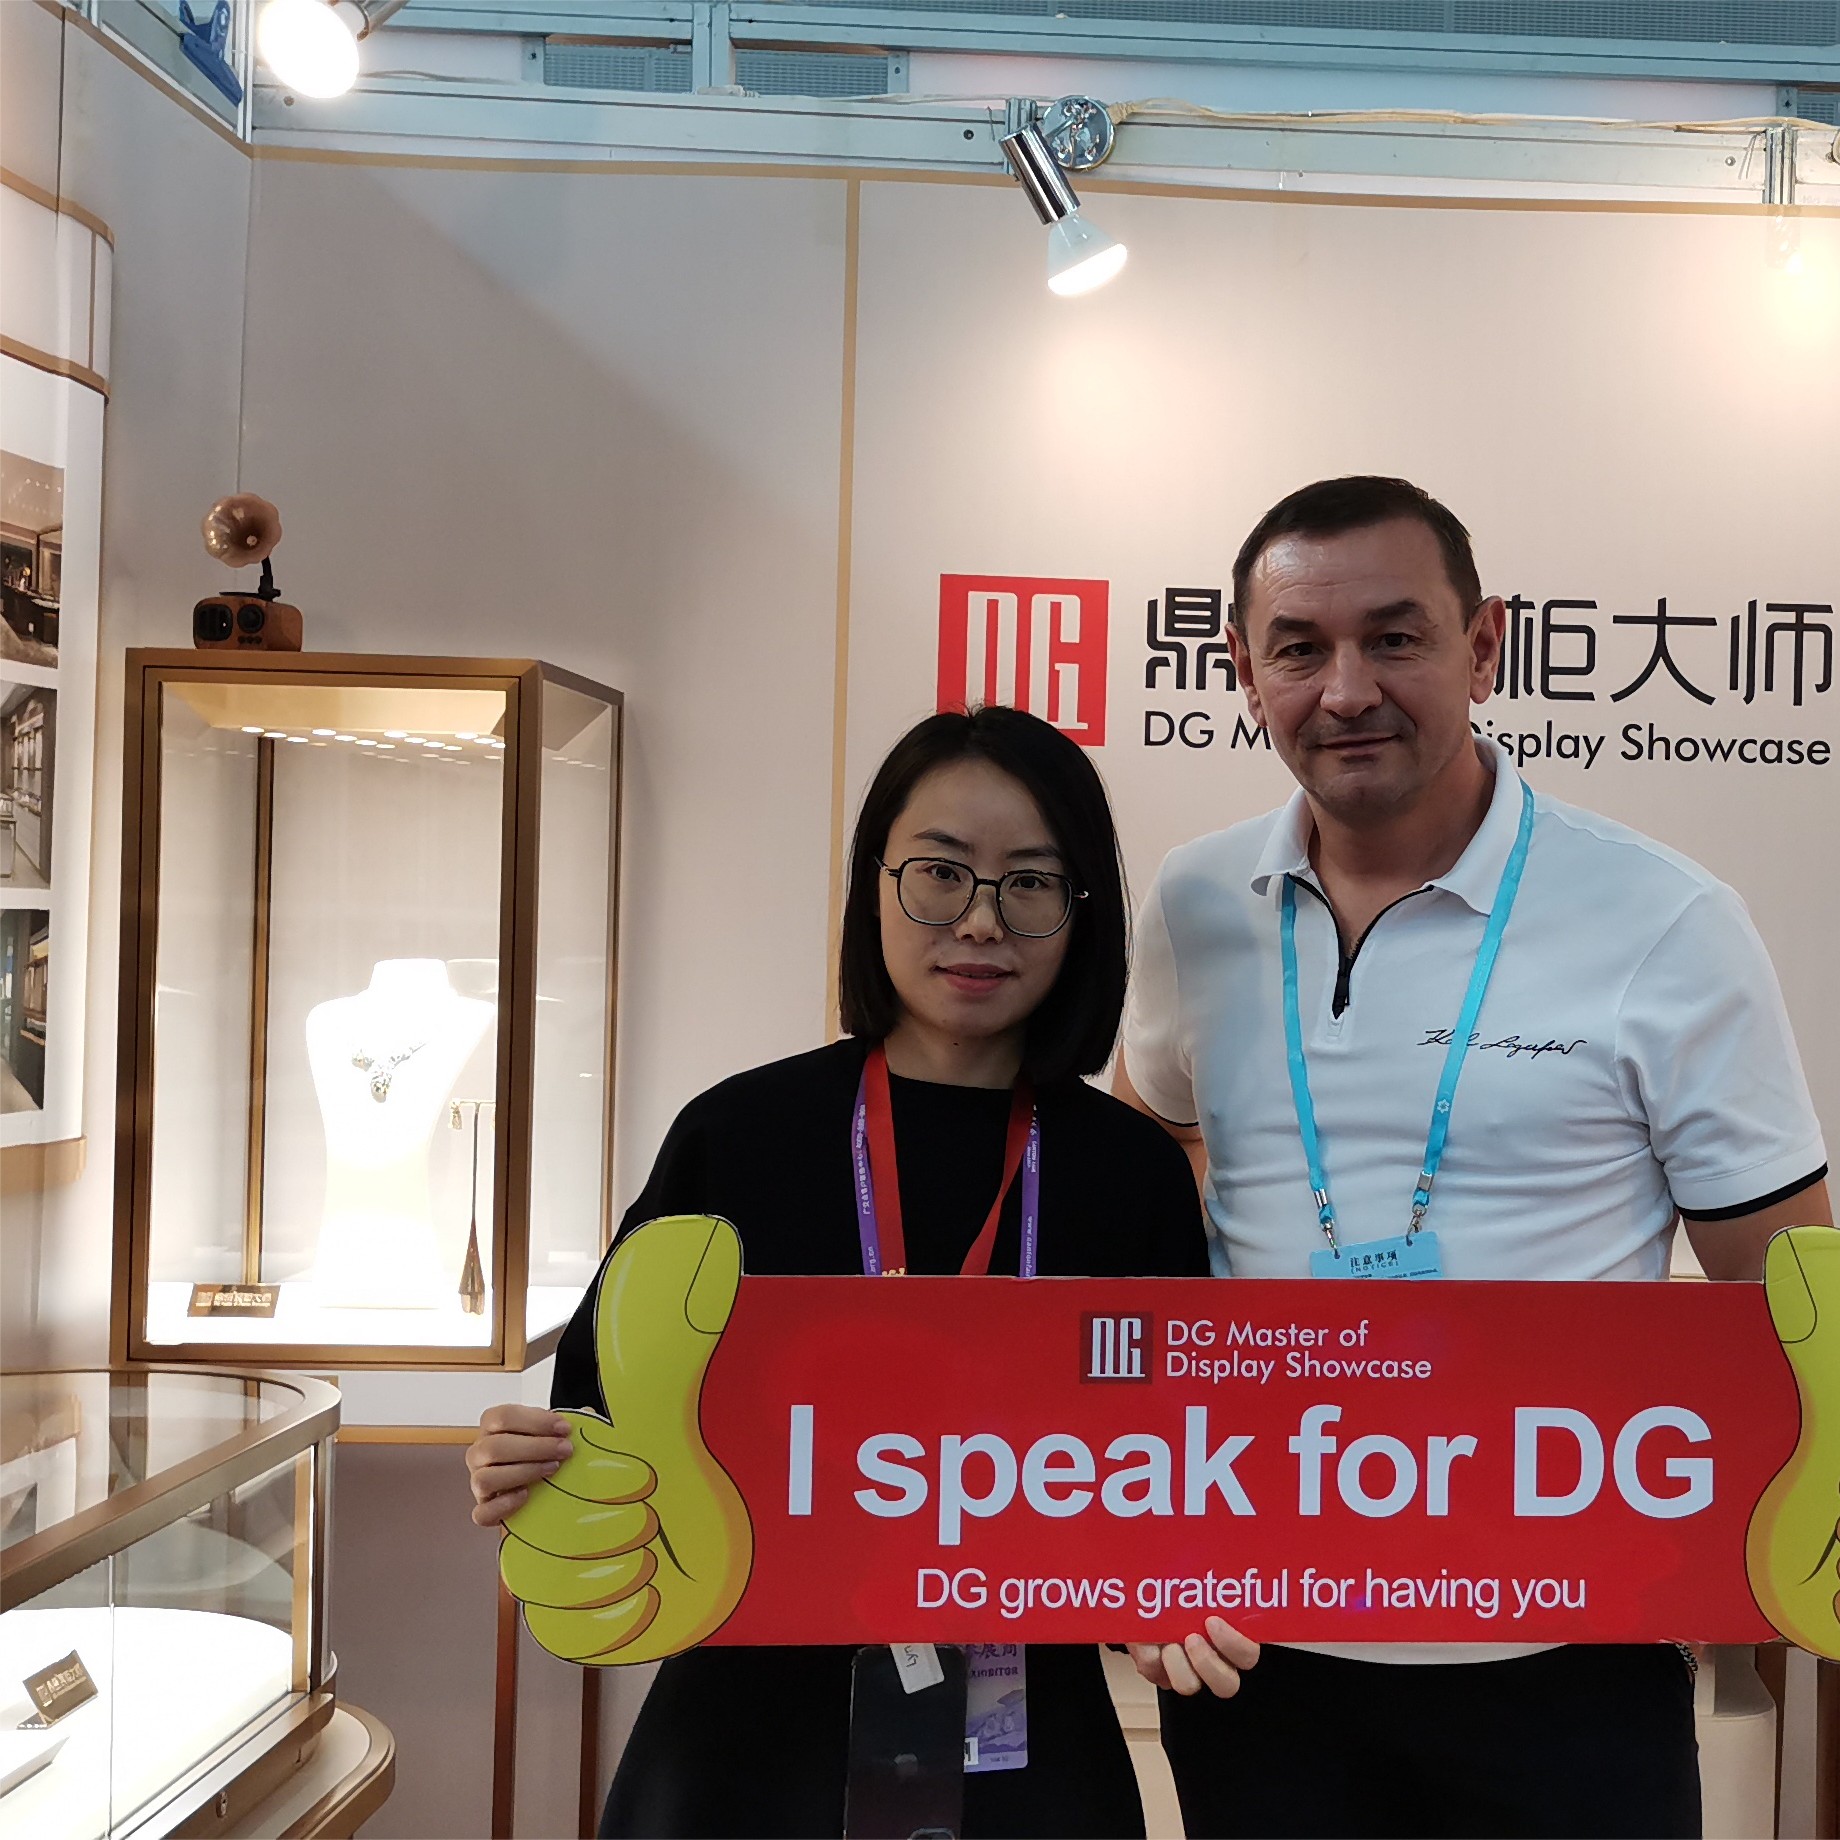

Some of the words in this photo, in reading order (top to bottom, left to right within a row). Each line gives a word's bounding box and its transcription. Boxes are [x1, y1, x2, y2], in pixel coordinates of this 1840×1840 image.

[1144, 710, 1215, 748] DG
[1620, 722, 1831, 765] Showcase
[1087, 1317, 1146, 1378] DG
[1166, 1320, 1216, 1346] DG
[1227, 1320, 1329, 1347] Master
[1339, 1319, 1369, 1347] of
[1166, 1351, 1276, 1385] Display
[1285, 1351, 1433, 1379] Showcase
[788, 1404, 814, 1516] I
[853, 1405, 1257, 1546] speak
[1288, 1404, 1479, 1518] for
[1513, 1405, 1714, 1519] DG
[916, 1567, 988, 1609] DG
[999, 1577, 1126, 1619] grows
[1136, 1567, 1289, 1619] grateful
[1299, 1567, 1355, 1608] for
[1365, 1567, 1500, 1619] having
[1511, 1577, 1586, 1619] you
